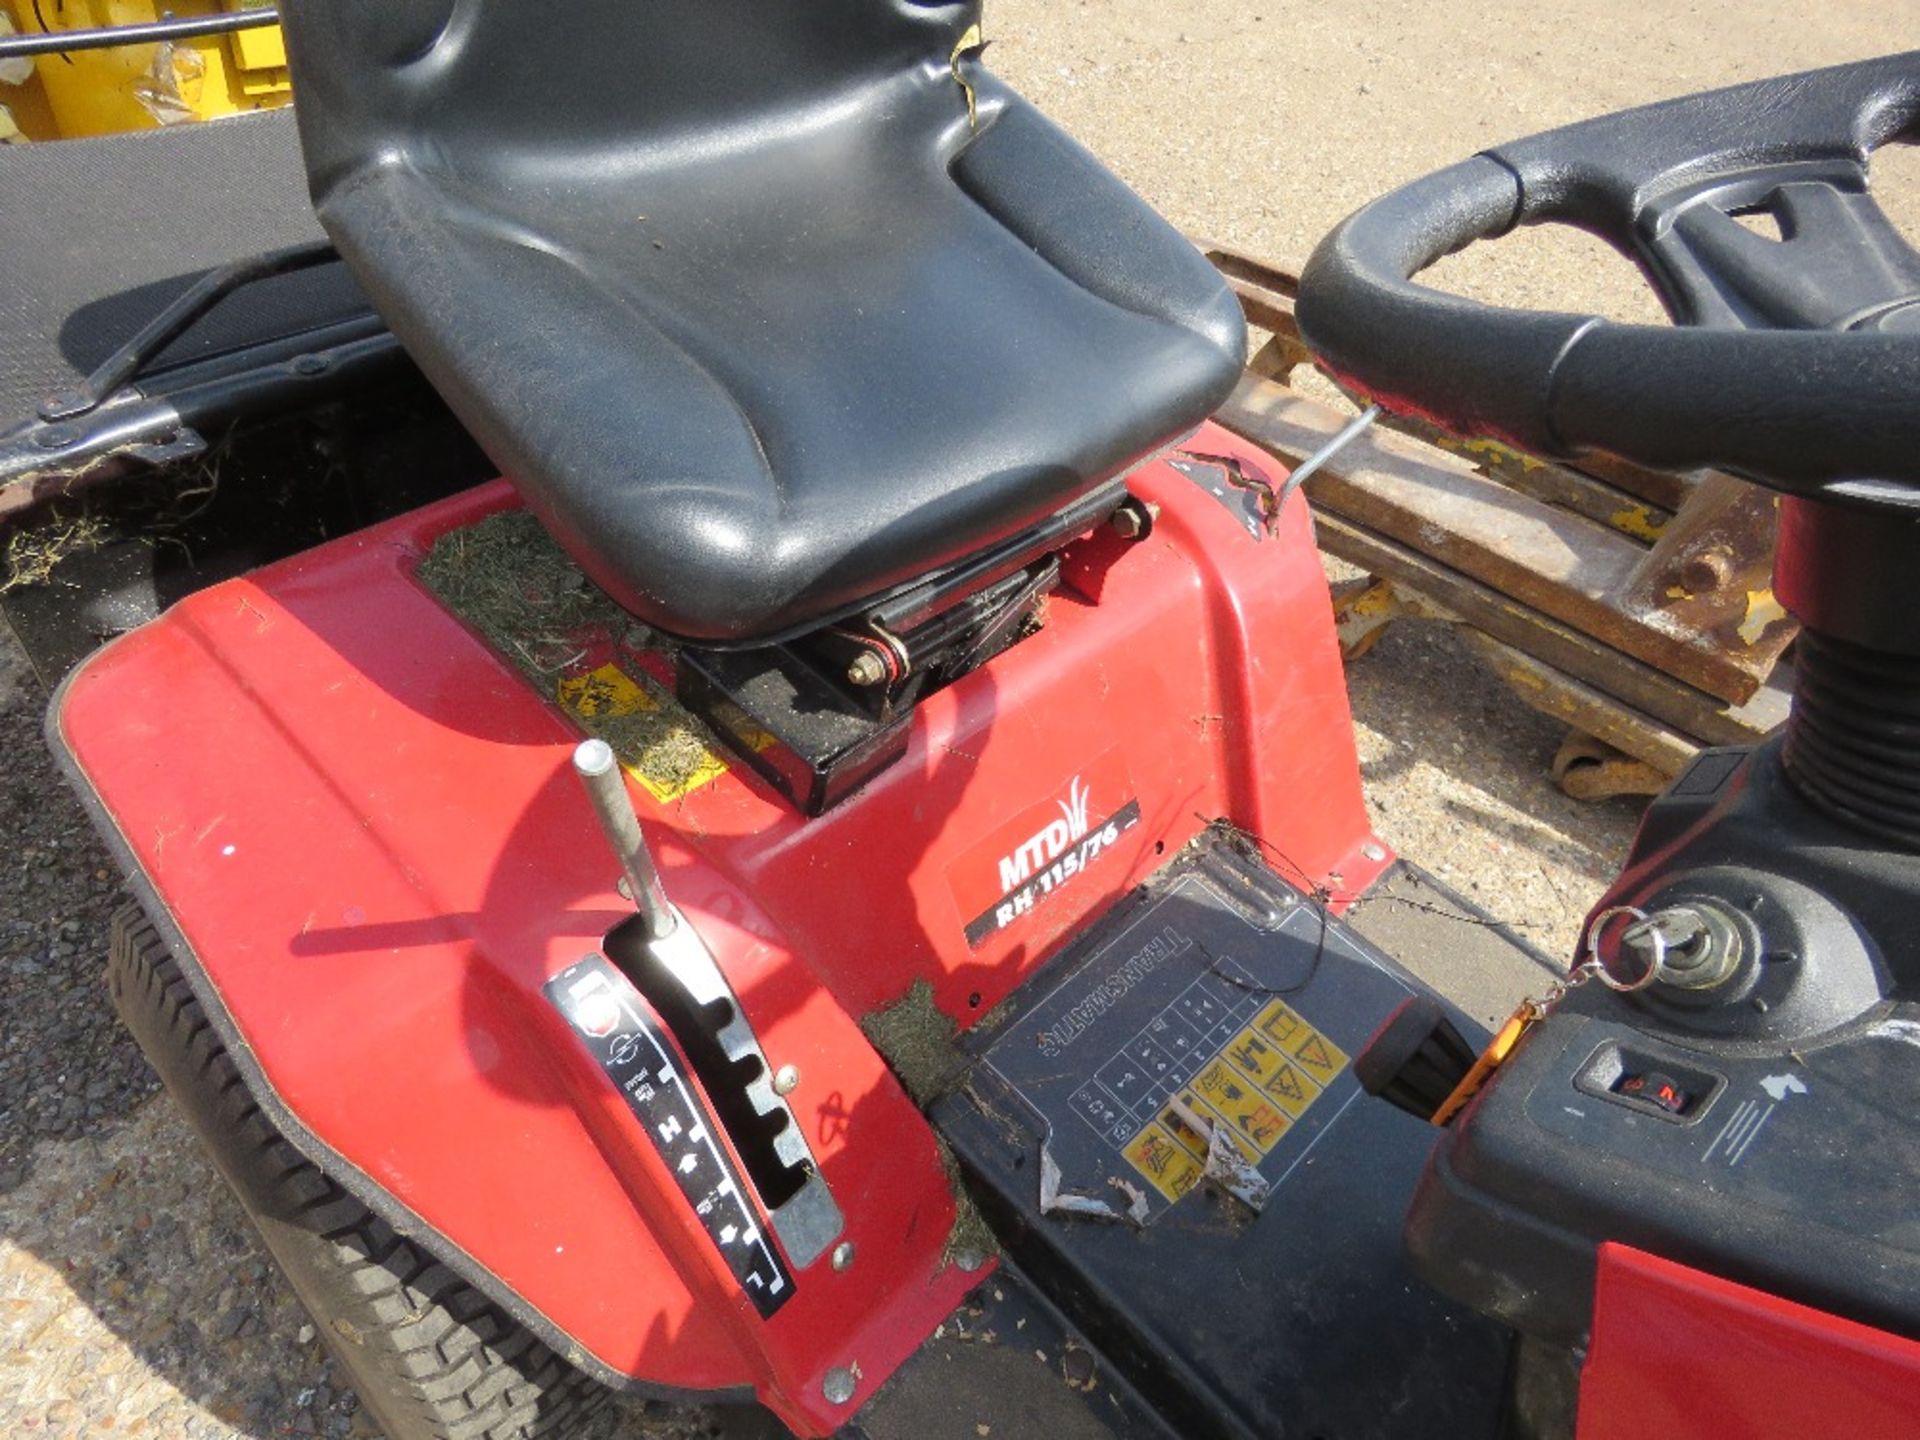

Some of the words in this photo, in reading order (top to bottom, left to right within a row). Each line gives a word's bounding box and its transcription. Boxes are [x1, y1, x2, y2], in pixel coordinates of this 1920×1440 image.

[996, 887, 1034, 928] RH
[1040, 822, 1119, 893] 115/76
[998, 818, 1069, 893] MTD
